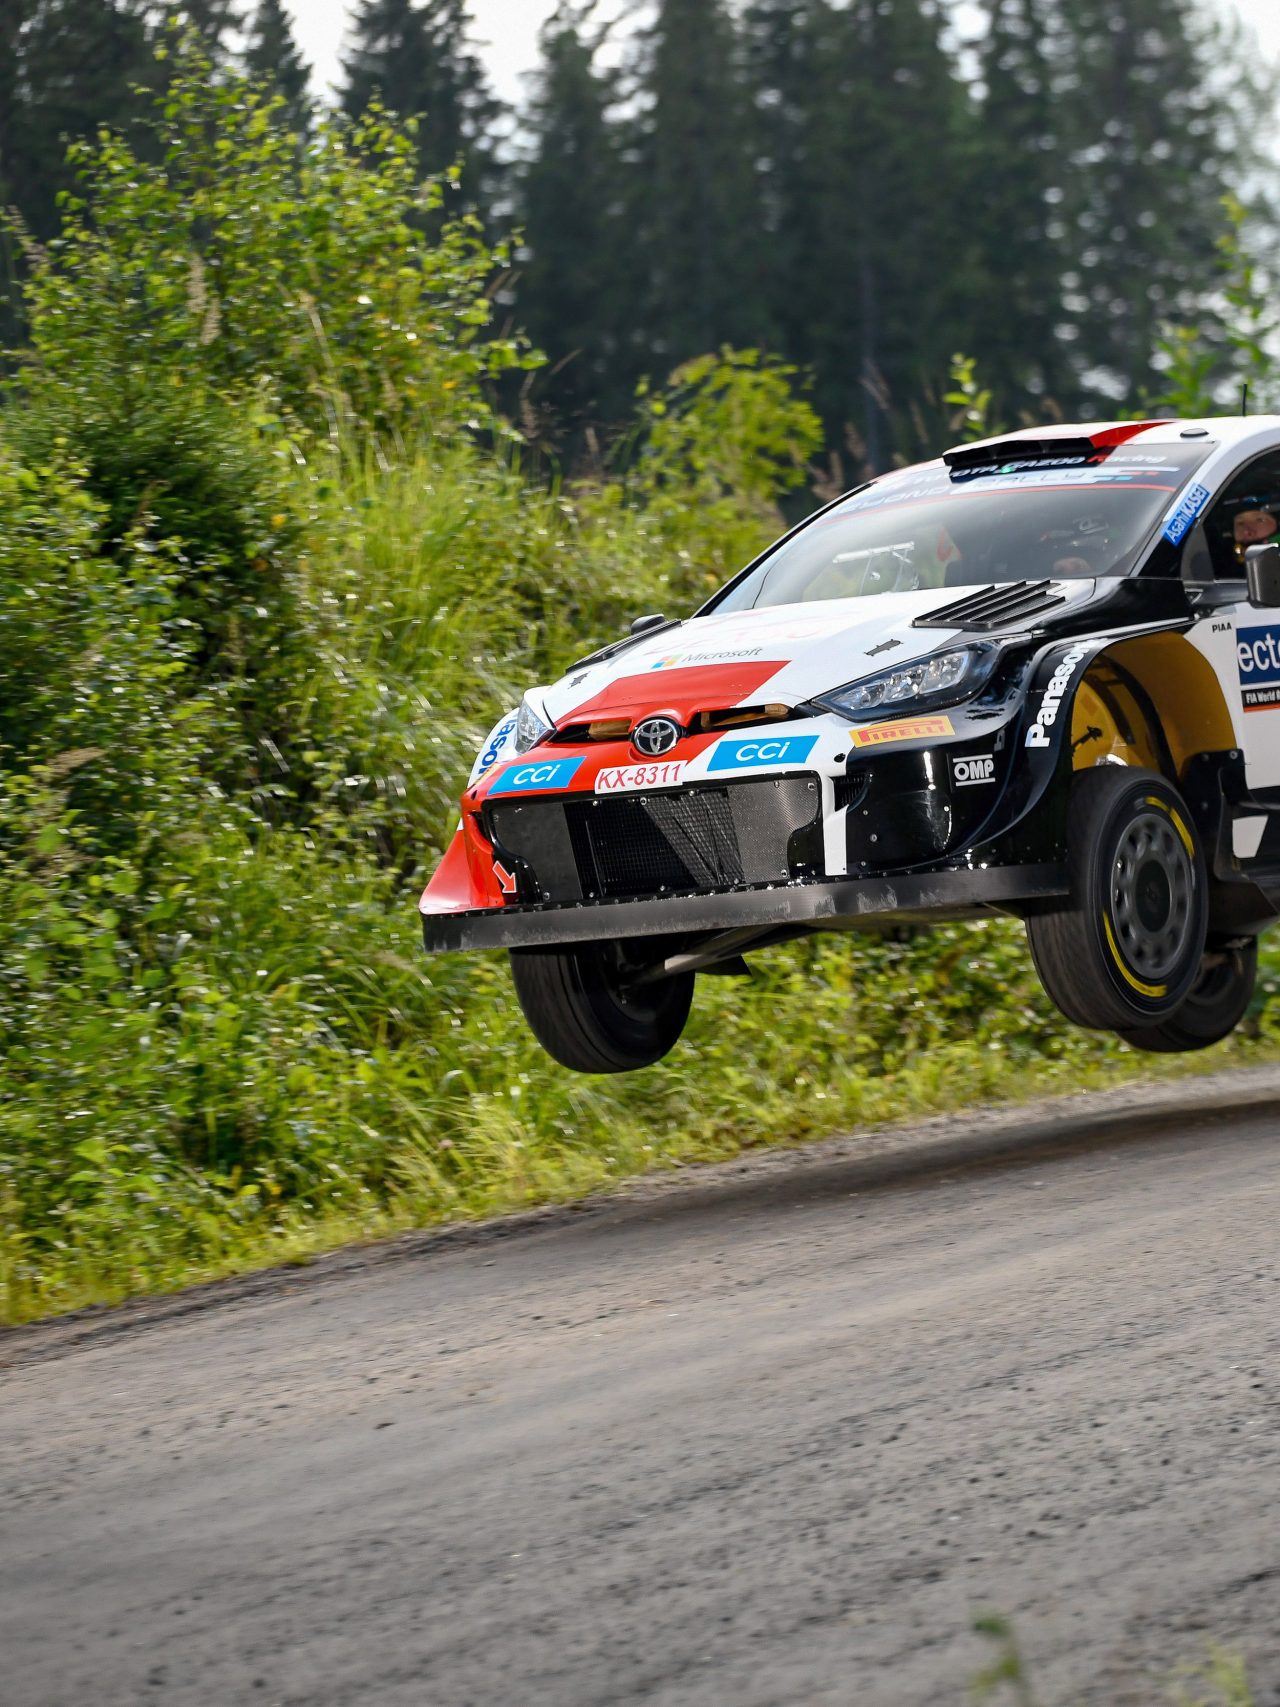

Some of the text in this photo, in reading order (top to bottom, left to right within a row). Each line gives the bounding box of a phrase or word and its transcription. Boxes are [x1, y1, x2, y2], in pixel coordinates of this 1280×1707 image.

[1211, 622, 1232, 633] PIAA
[682, 646, 763, 664] Microsoft
[858, 720, 945, 742] PIRELLI
[598, 763, 681, 790] KX-8311
[954, 759, 994, 781] OMP
